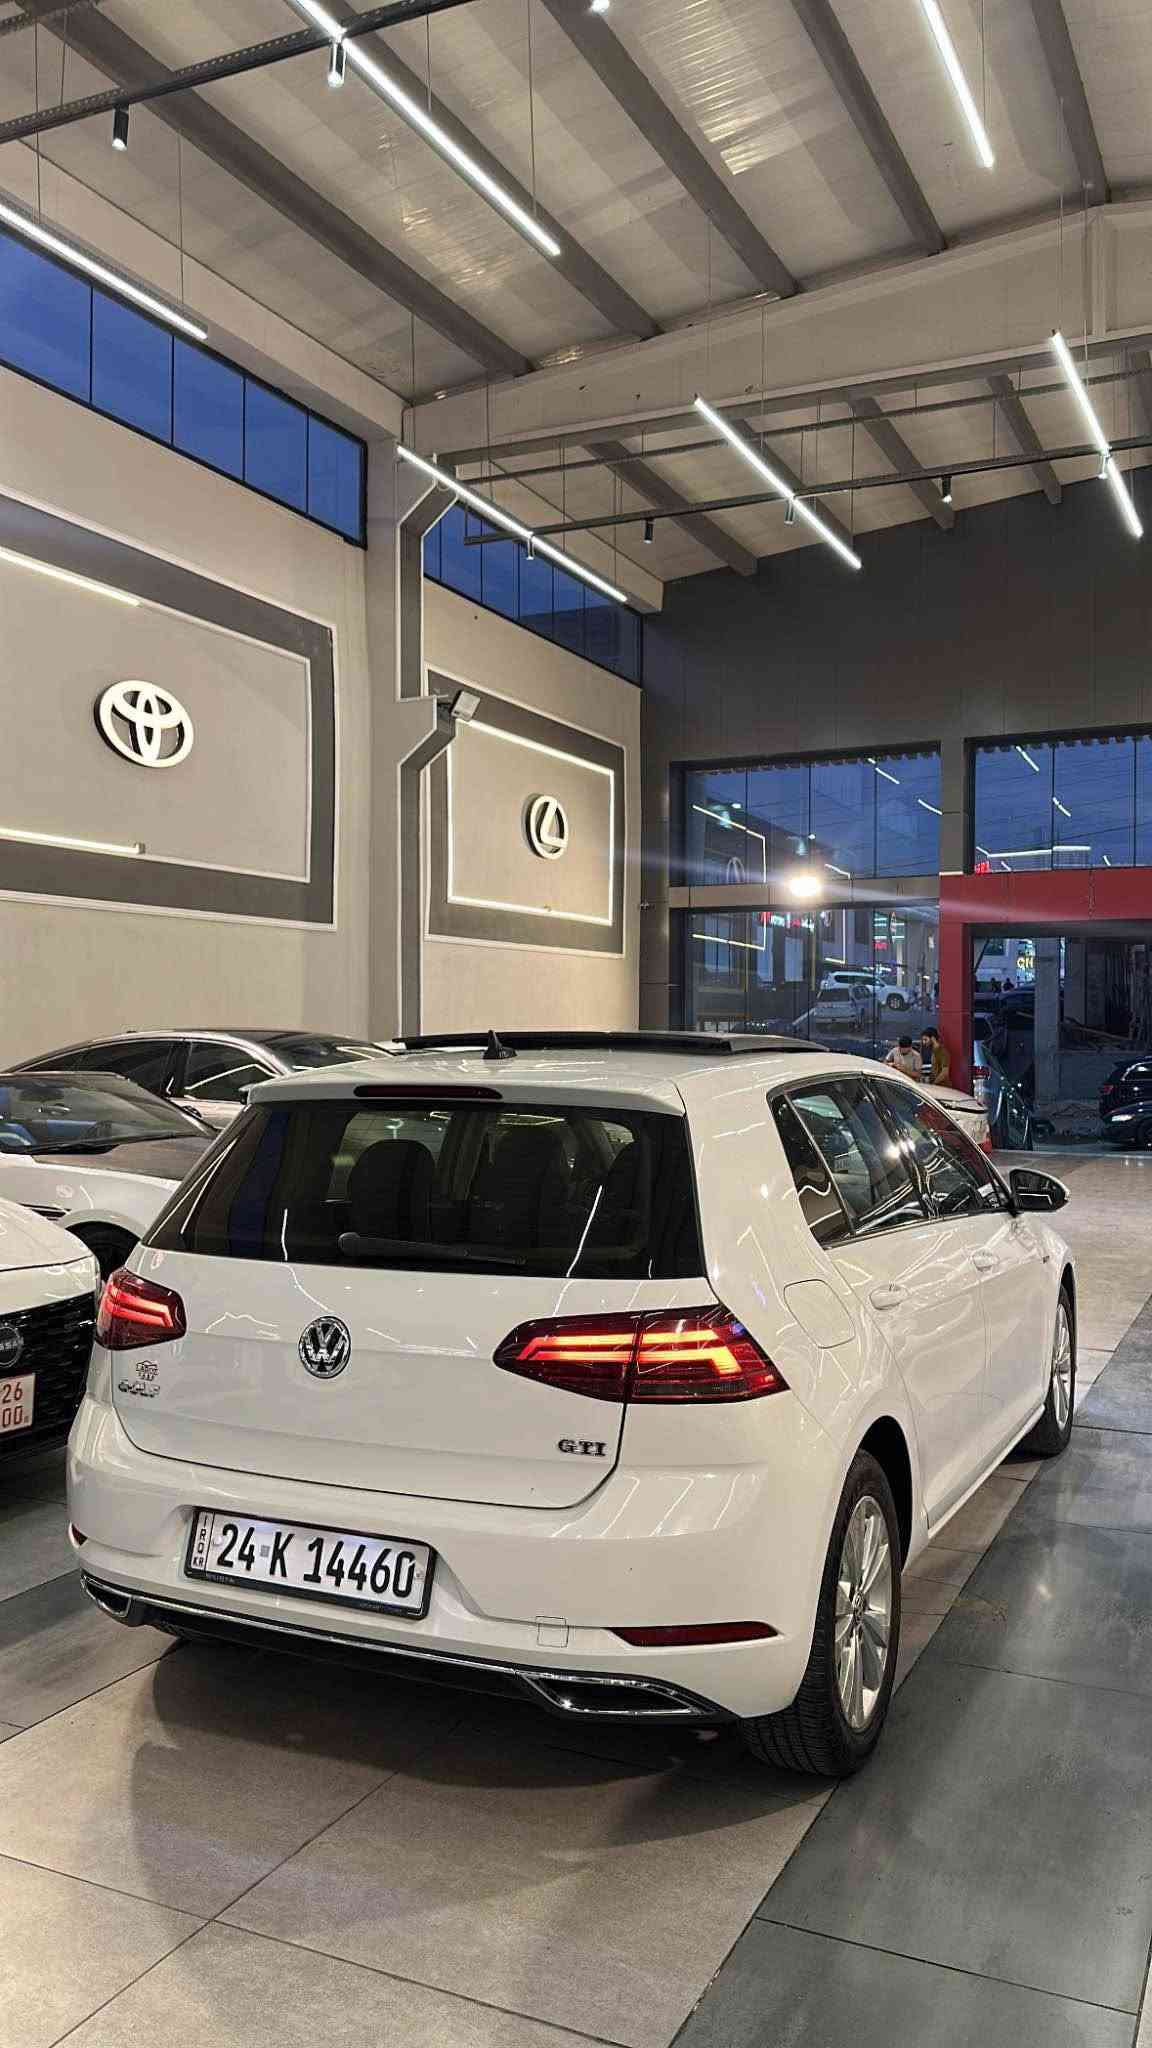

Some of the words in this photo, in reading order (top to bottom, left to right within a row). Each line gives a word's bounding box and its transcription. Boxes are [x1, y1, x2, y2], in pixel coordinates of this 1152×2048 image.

[2, 1382, 23, 1404] 26
[2, 1406, 23, 1428] 00
[558, 1439, 606, 1457] GTI
[216, 1523, 256, 1571] 24
[269, 1531, 295, 1578] K
[303, 1537, 416, 1598] 14460
